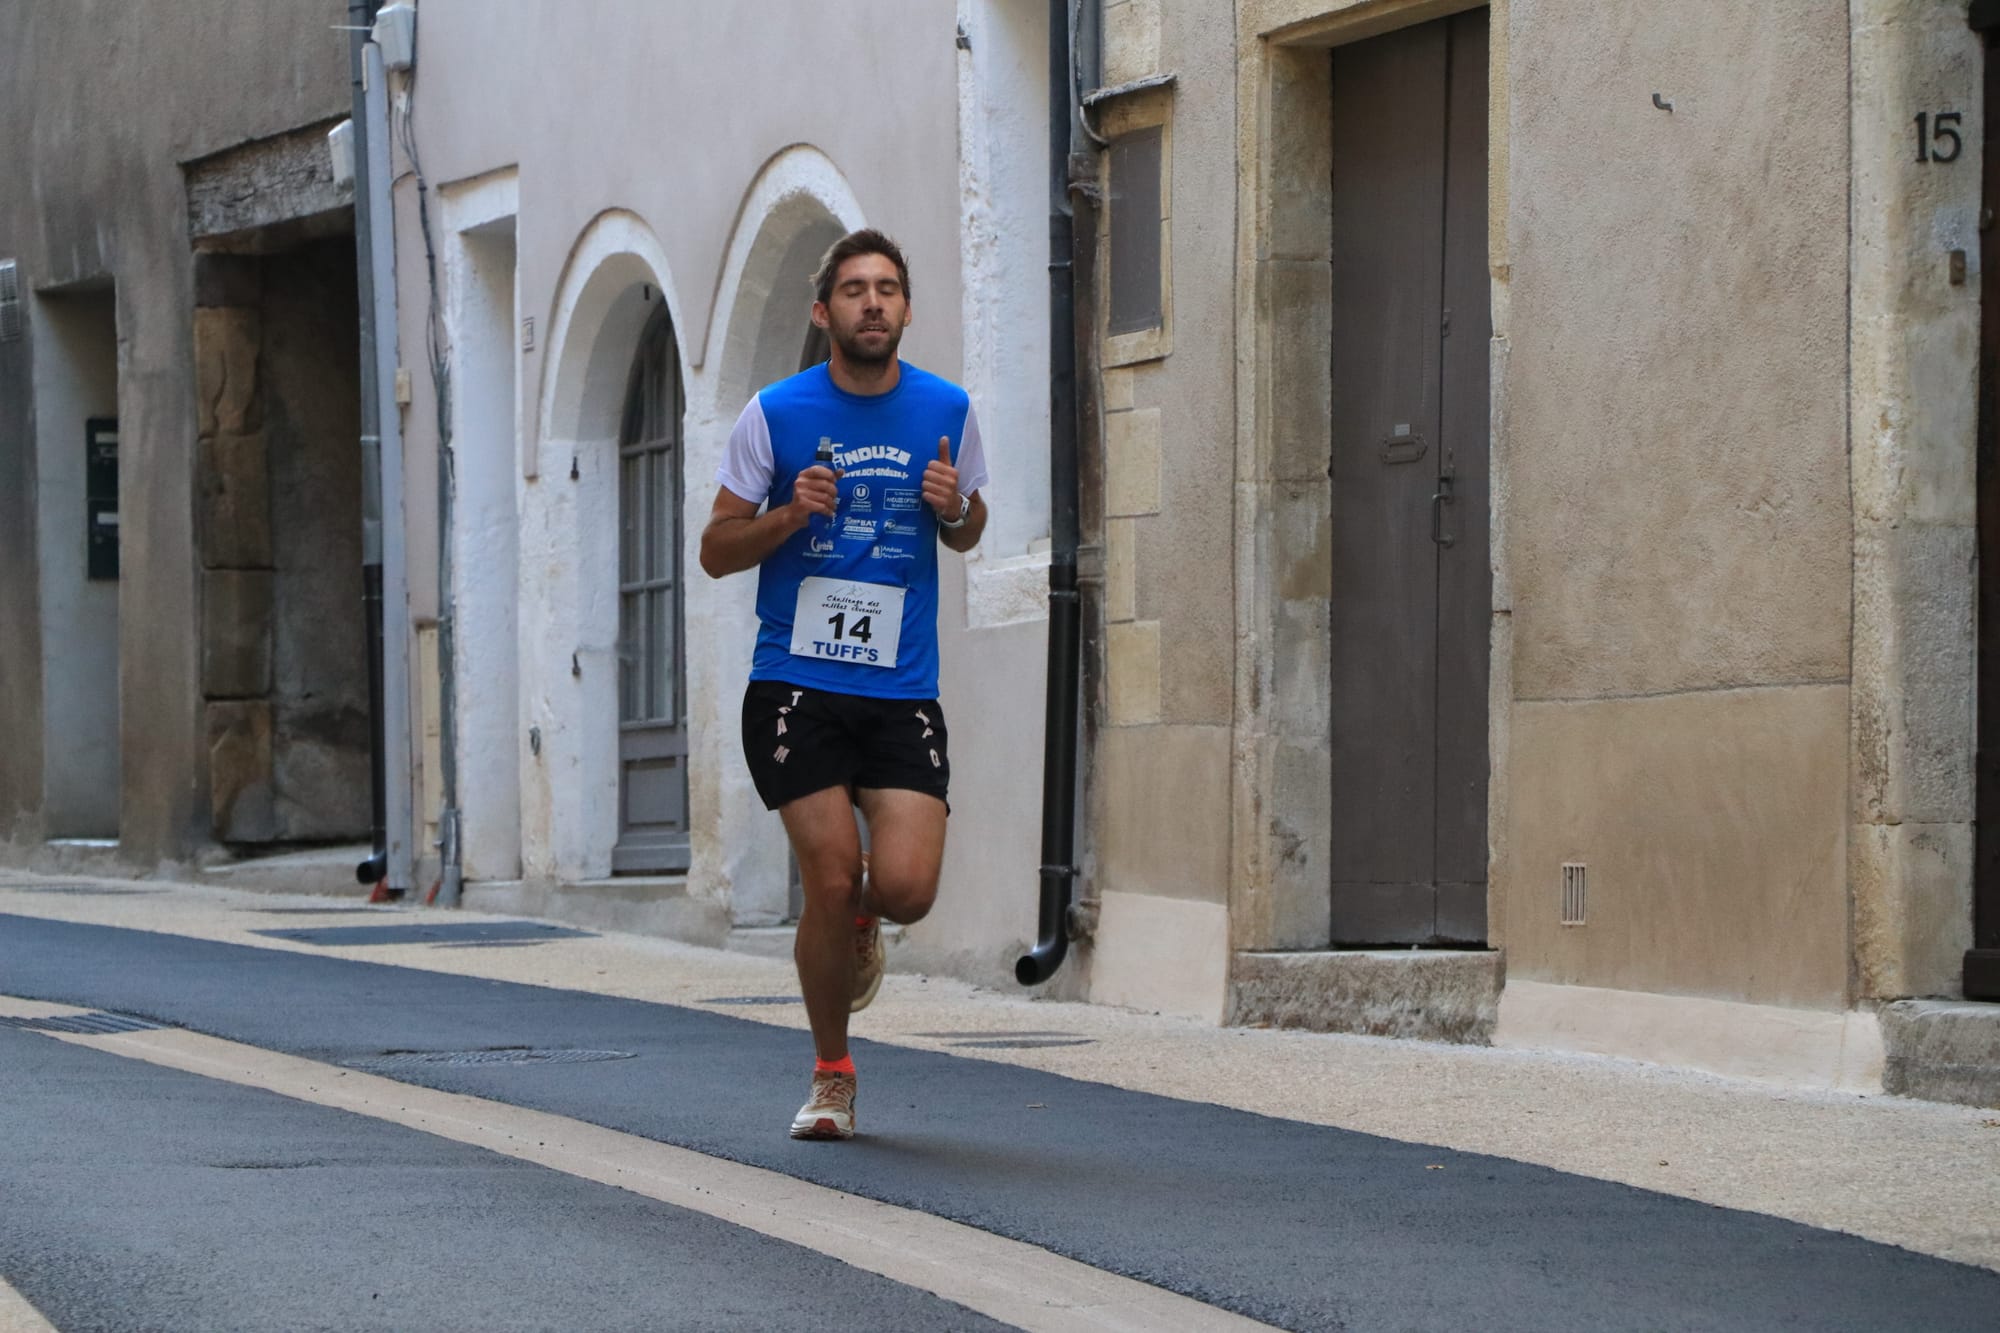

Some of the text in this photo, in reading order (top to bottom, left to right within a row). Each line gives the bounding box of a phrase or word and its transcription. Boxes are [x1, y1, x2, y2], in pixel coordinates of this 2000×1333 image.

[1914, 111, 1962, 163] 15
[828, 612, 872, 643] 14
[812, 641, 879, 662] TUFF'S
